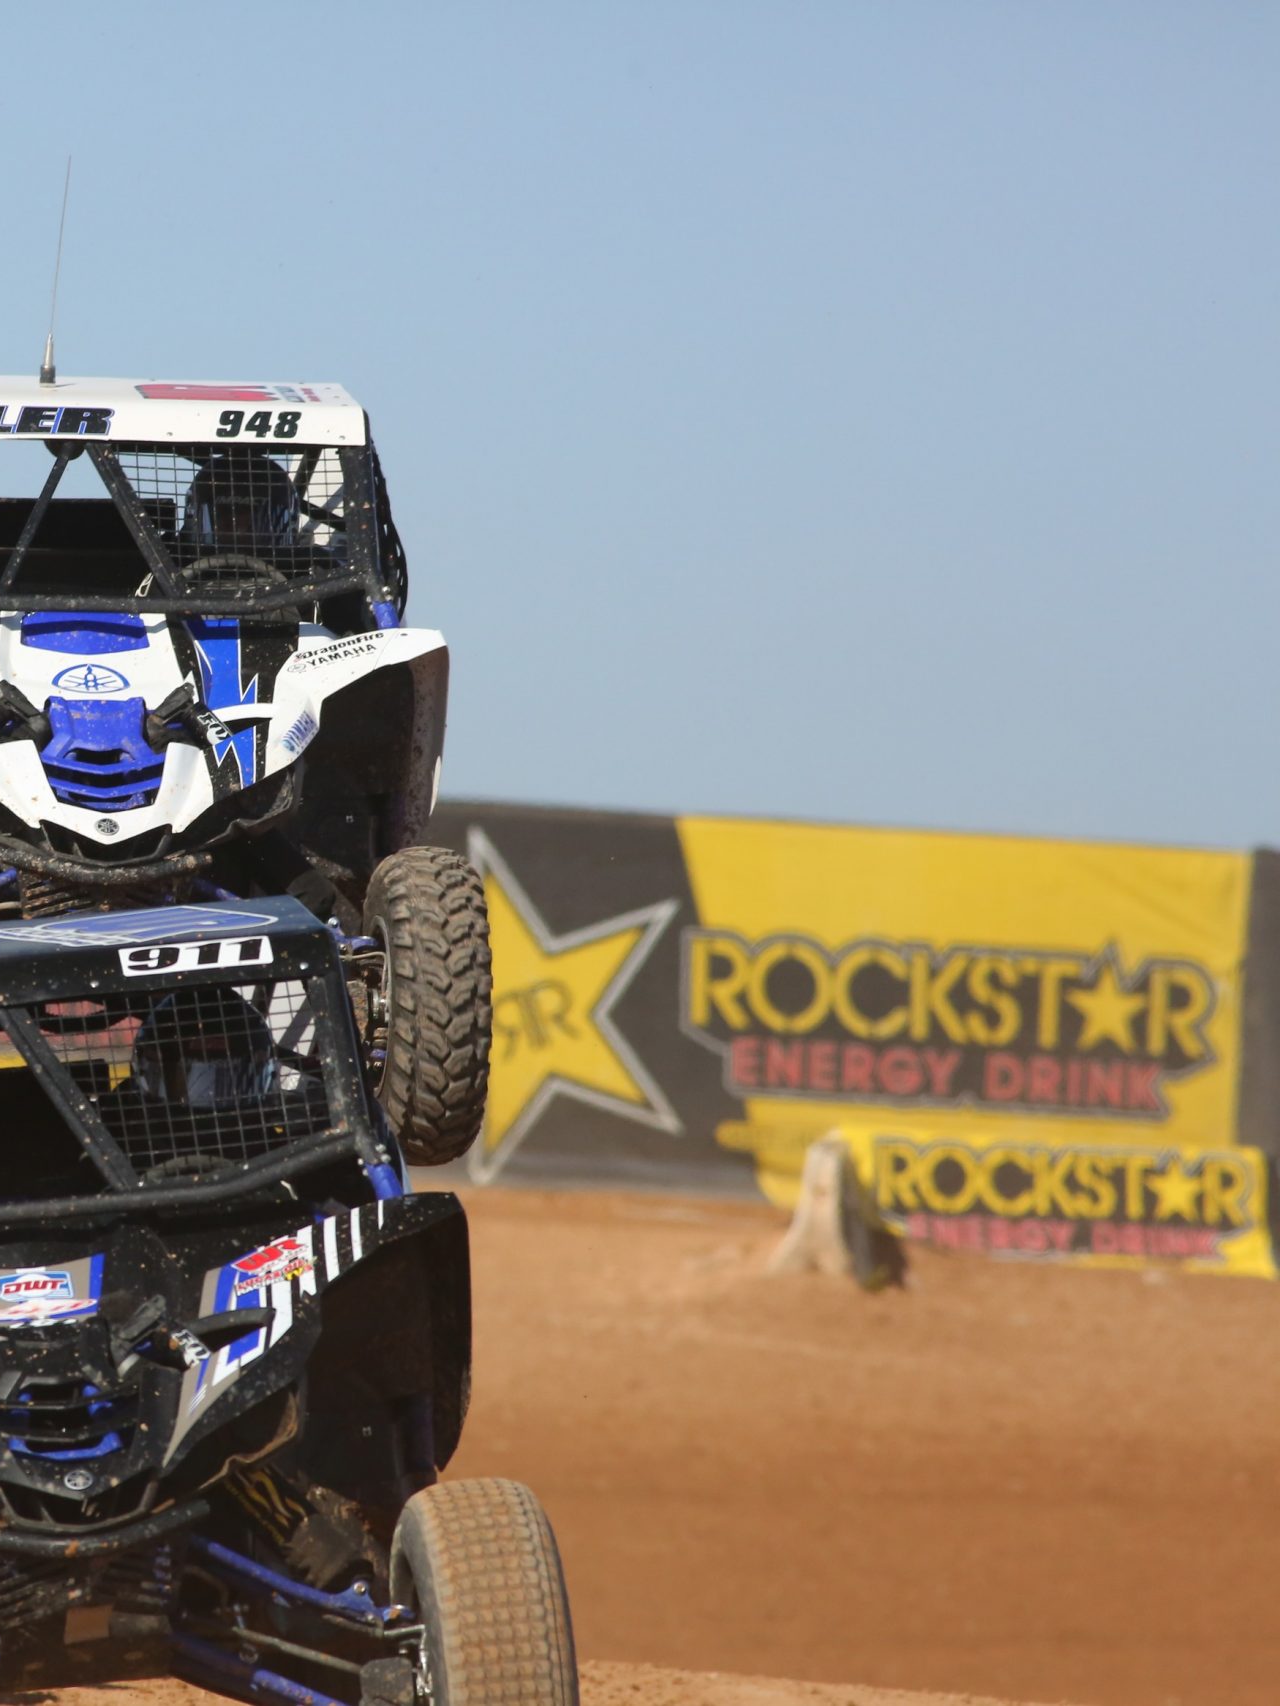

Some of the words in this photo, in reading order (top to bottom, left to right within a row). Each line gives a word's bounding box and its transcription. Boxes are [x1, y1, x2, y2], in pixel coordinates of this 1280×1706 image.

[216, 410, 302, 438] 948
[306, 643, 377, 667] YAMAHA
[128, 938, 265, 972] 911
[730, 1036, 961, 1096] ENERGY
[983, 1051, 1164, 1111] DRINK
[3, 1279, 65, 1296] DWT
